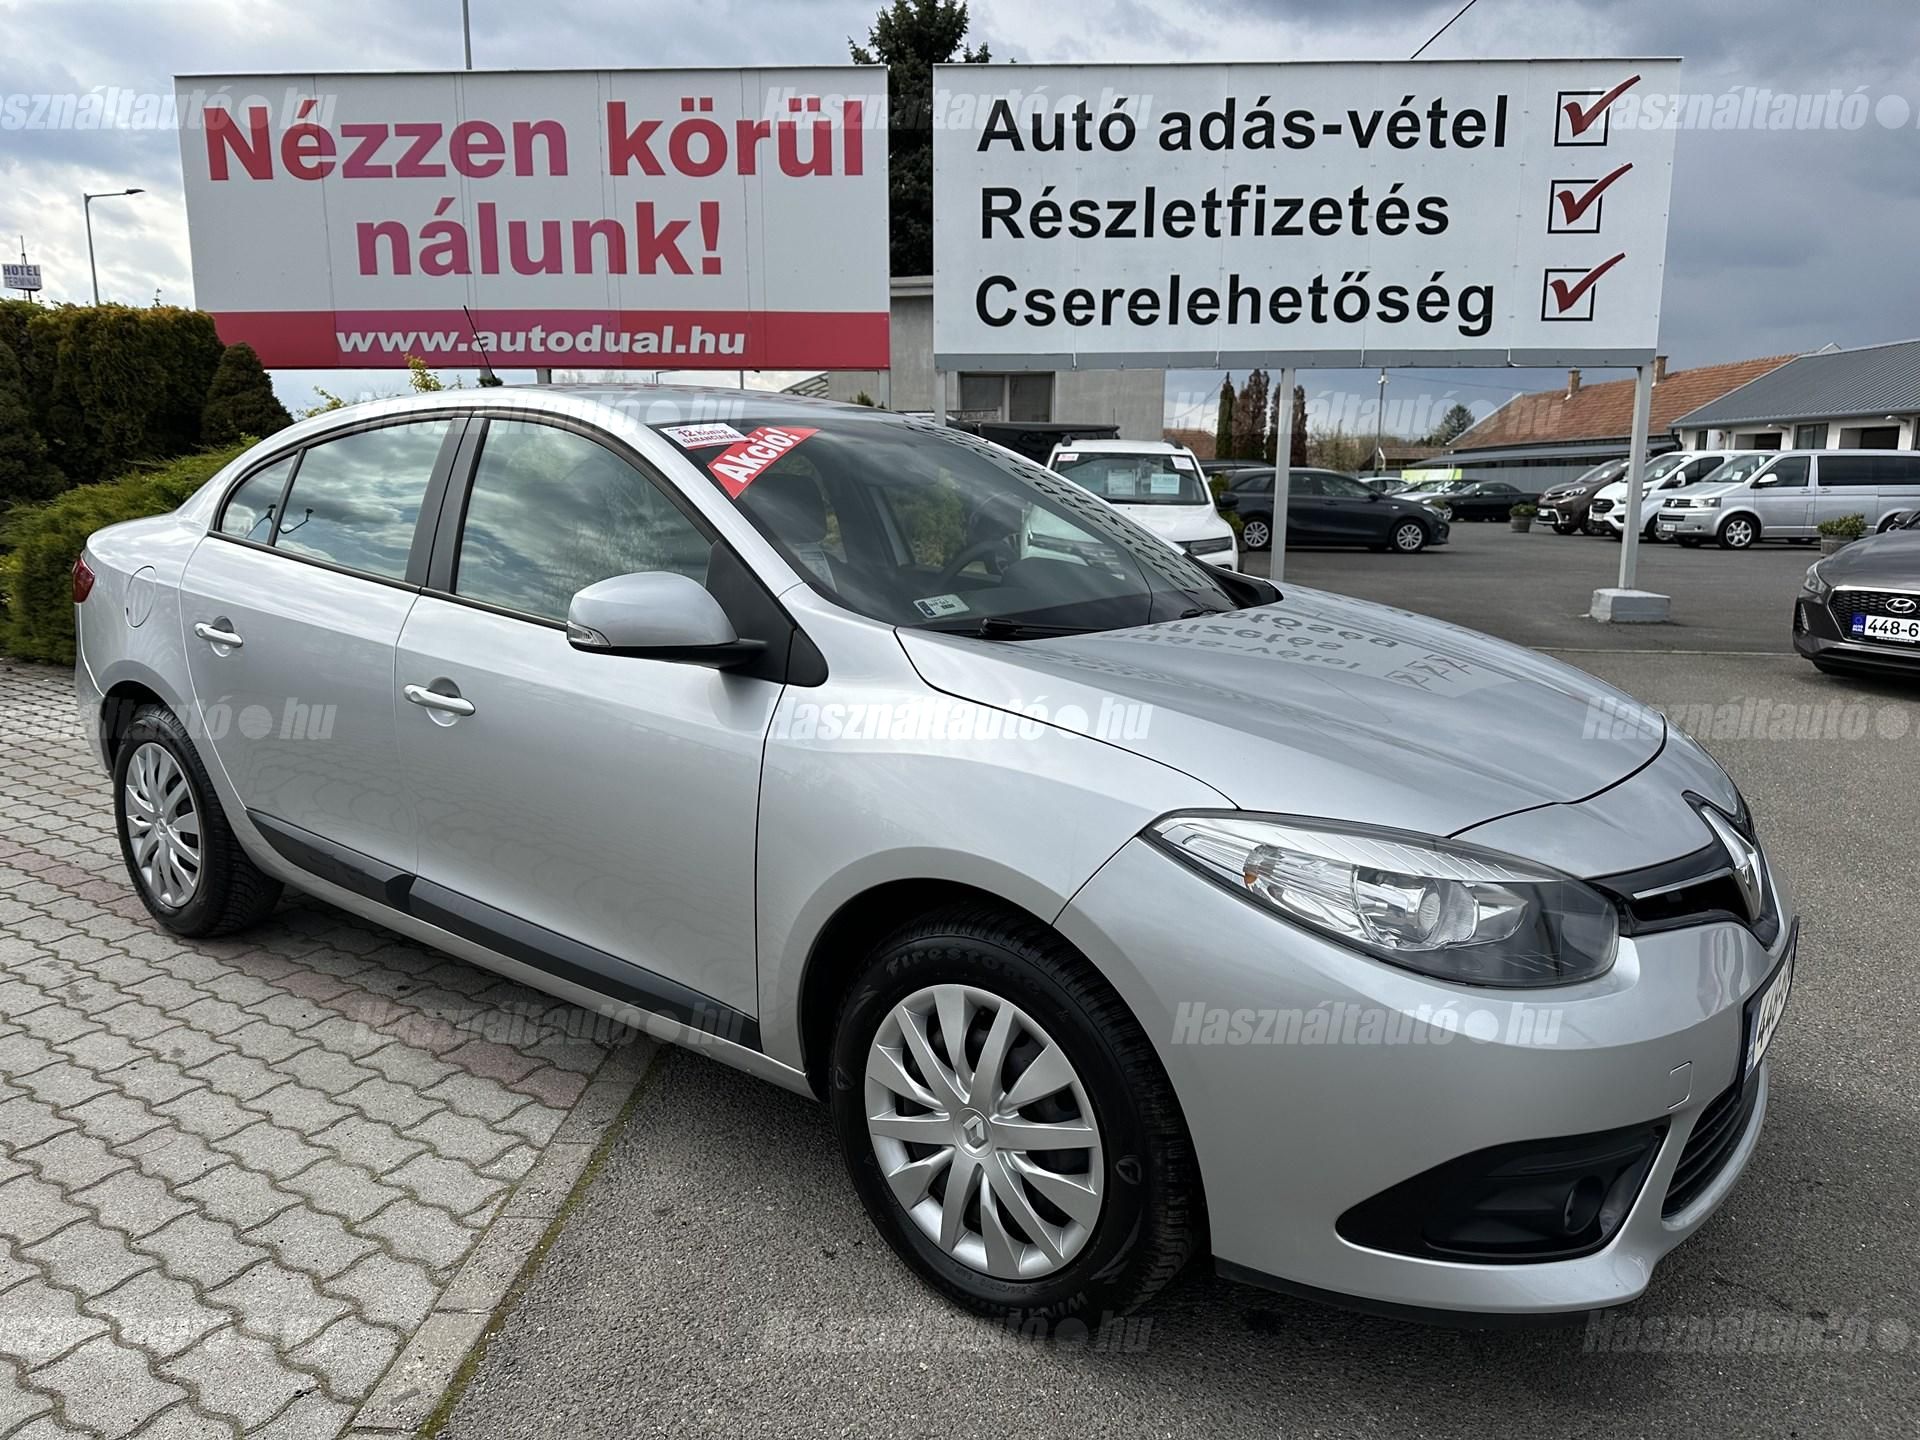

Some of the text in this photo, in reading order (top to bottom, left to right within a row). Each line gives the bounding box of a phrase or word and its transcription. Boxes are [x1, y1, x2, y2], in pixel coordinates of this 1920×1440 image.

[202, 96, 864, 181] Nézzen körül
[977, 94, 1508, 152] Autó adás-vétel
[356, 197, 722, 276] nálunk!
[981, 182, 1450, 240] Részletfizetés
[3, 265, 40, 276] HOTEL
[976, 271, 1494, 337] Cserelehetőség
[336, 324, 745, 355] www.autodual.hu
[713, 427, 801, 484] Akció!
[1867, 618, 1920, 638] 448-6
